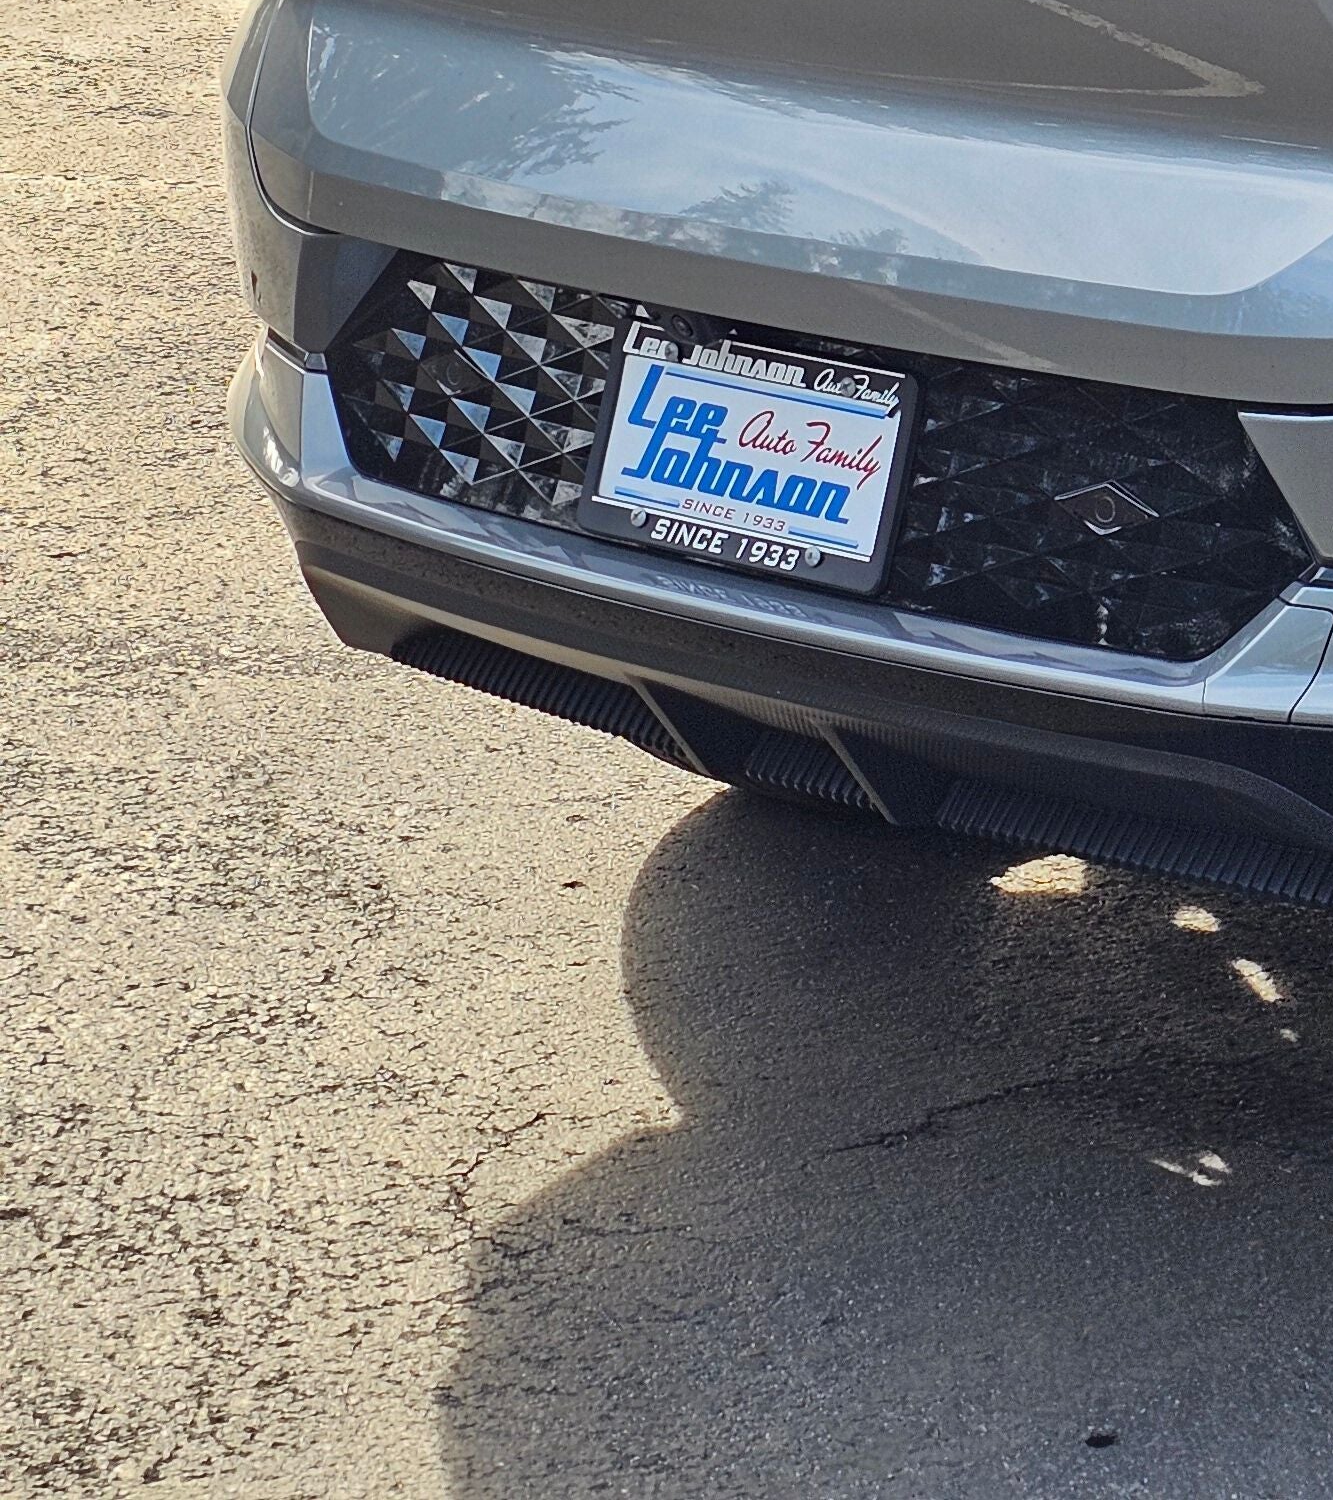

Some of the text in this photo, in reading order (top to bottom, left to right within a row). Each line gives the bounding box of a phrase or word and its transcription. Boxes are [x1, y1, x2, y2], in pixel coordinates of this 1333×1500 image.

[627, 363, 728, 438] Lee
[621, 432, 851, 524] Johnson
[738, 410, 882, 490] Auto Family
[650, 518, 801, 572] SINCE 1933
[681, 498, 786, 533] SINCE 1933
